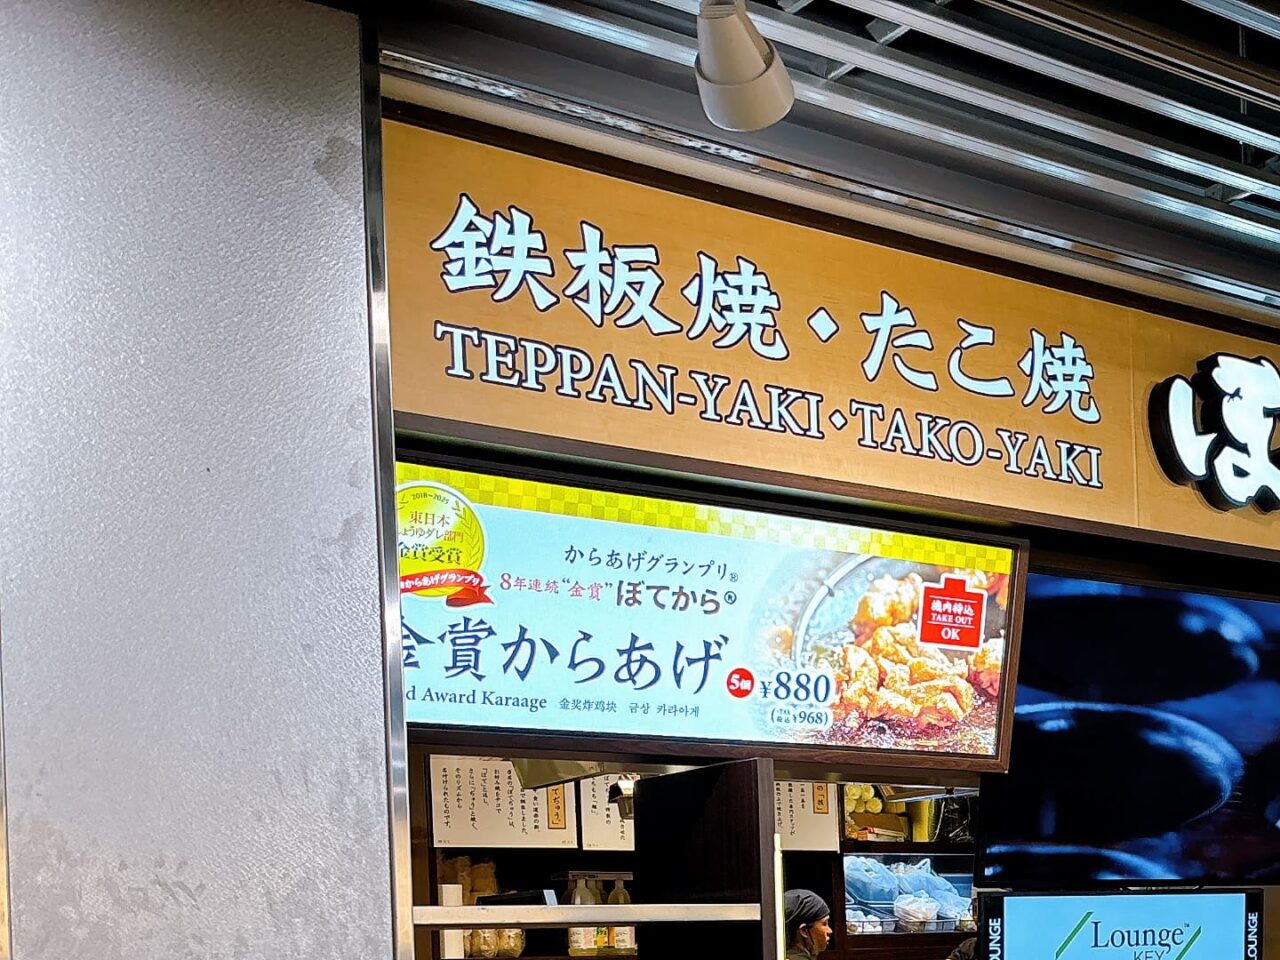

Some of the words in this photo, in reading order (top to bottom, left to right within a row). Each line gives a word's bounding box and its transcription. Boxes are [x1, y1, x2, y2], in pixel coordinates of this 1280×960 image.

[409, 510, 451, 528] 東日本
[930, 612, 953, 623] TAKE
[954, 614, 973, 626] OUT
[940, 627, 961, 642] OK
[759, 671, 831, 703] ¥880
[421, 686, 477, 704] Award
[481, 691, 548, 713] Karaage
